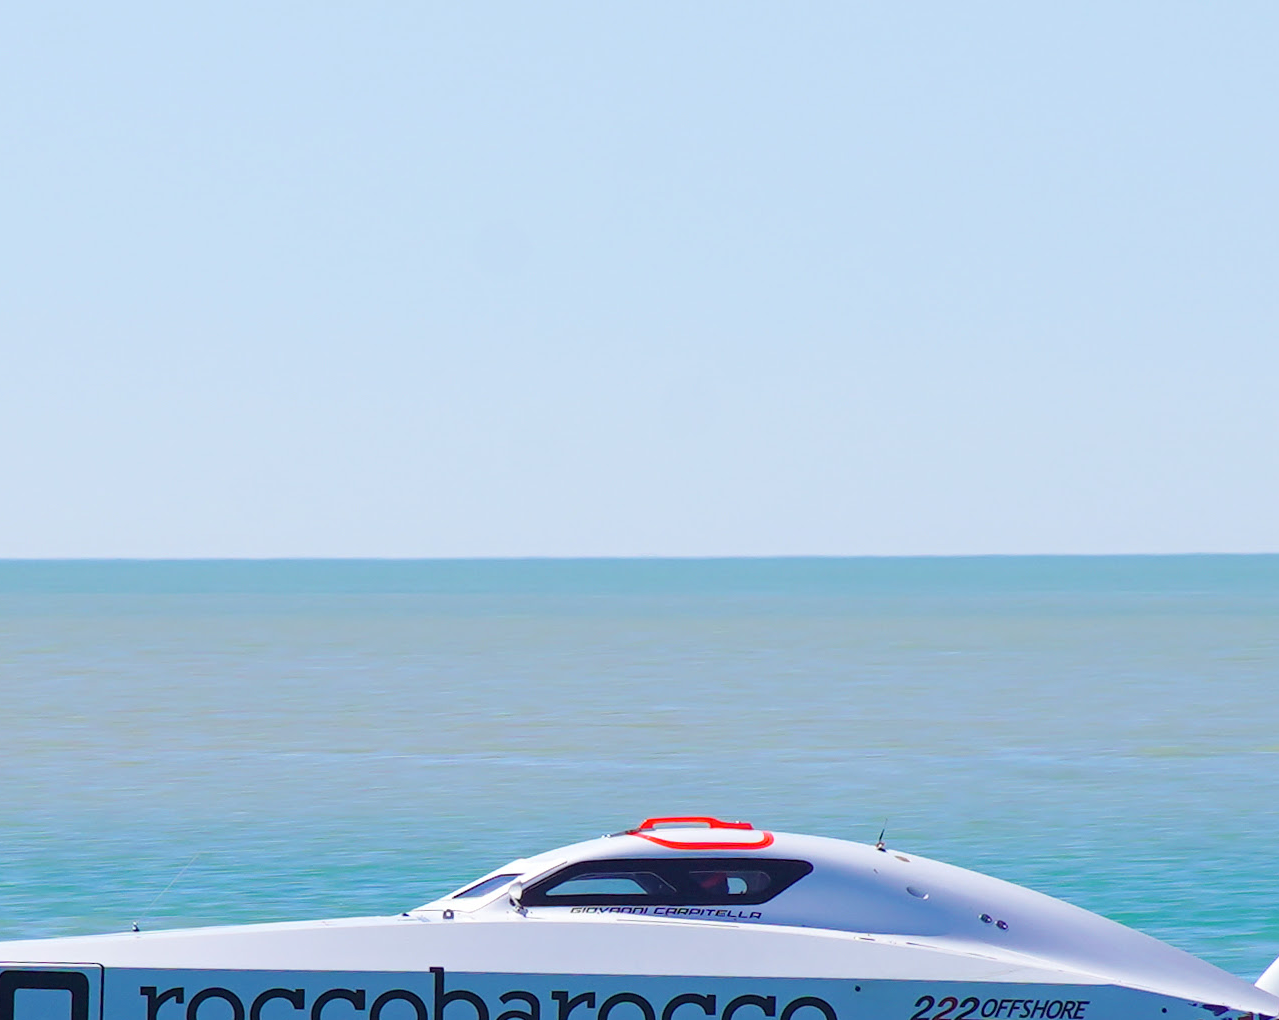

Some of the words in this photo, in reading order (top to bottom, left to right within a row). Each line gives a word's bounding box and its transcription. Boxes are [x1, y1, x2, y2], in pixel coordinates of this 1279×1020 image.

[570, 906, 649, 915] GIOVANNI
[653, 907, 763, 920] CARPITELLA
[980, 997, 1091, 1020] OFFSHORE
